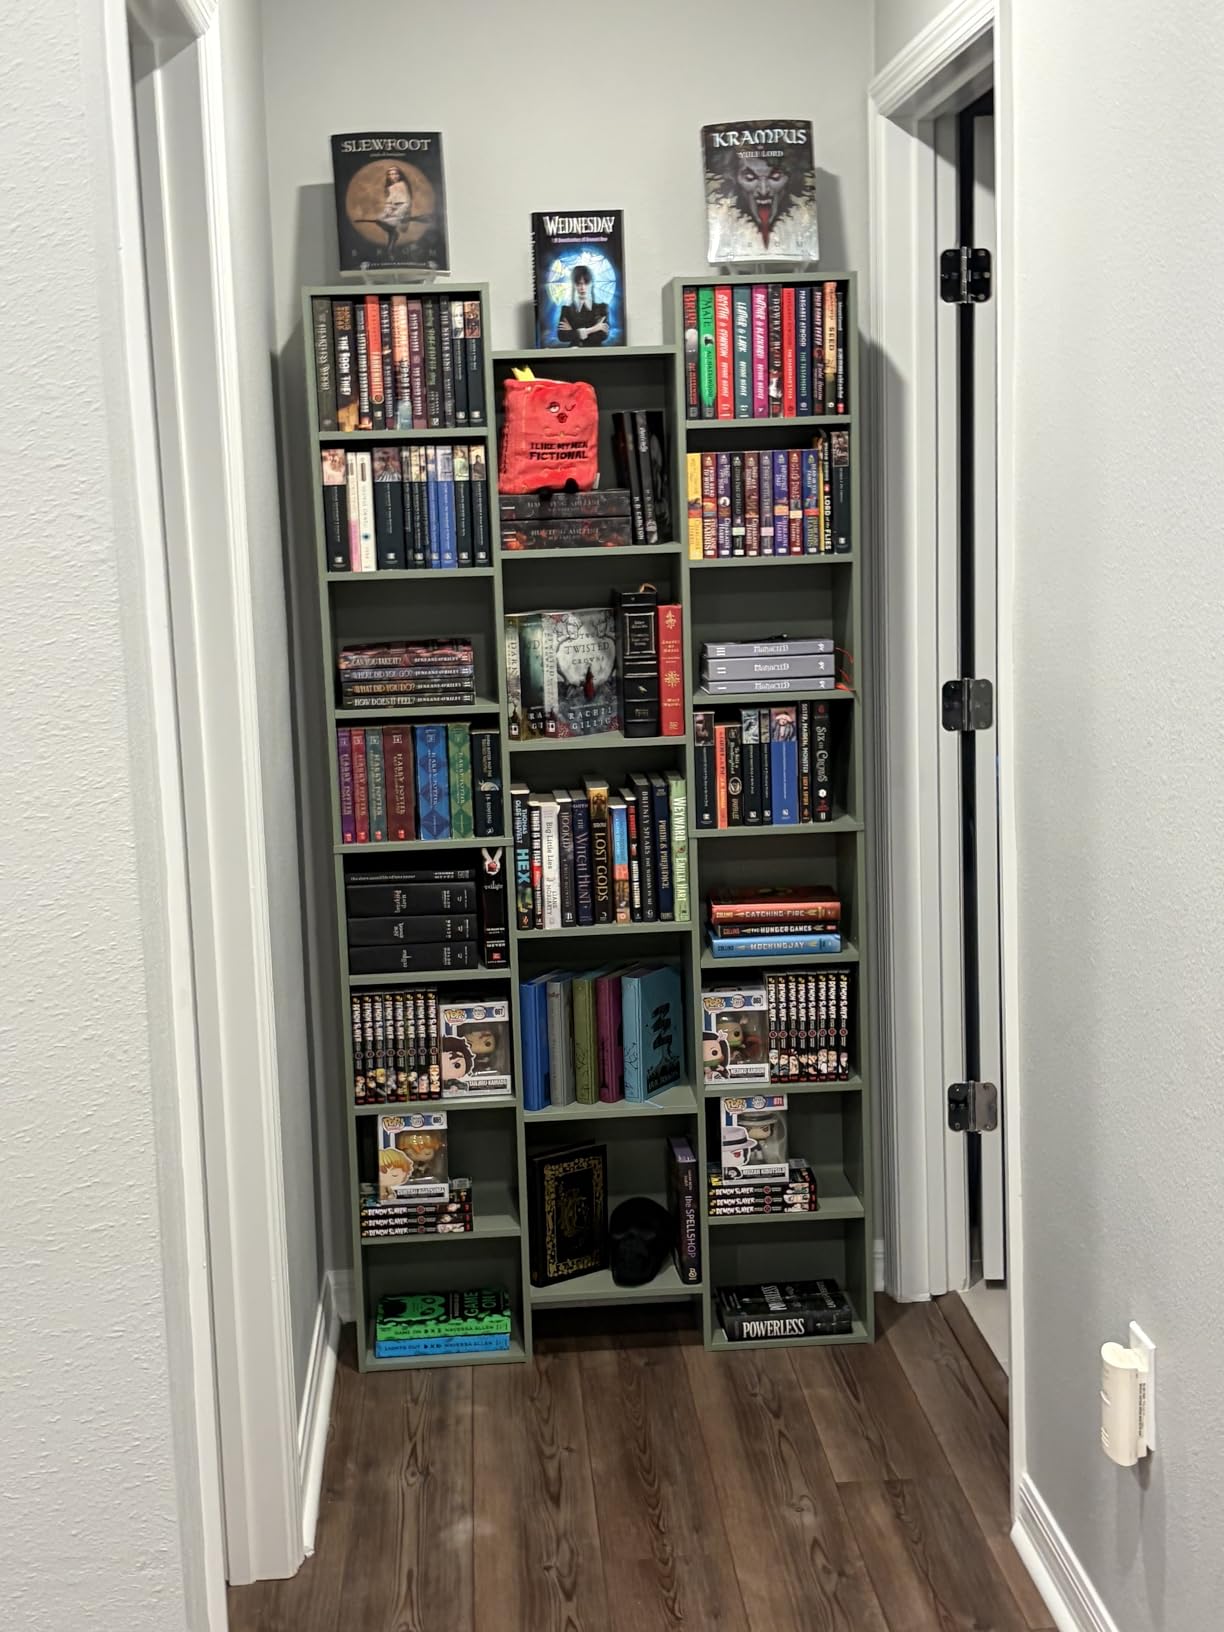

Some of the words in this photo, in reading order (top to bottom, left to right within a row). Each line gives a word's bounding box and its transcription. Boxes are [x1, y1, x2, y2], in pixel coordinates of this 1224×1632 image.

[342, 139, 431, 152] SLEWFOOT
[712, 128, 807, 147] KRAMPUS
[543, 216, 615, 236] WEDNESDAY
[684, 293, 697, 326] BRIDE
[701, 298, 712, 328] MATE
[718, 294, 729, 319] SCYTHE
[736, 302, 748, 327] LEATHER
[755, 294, 767, 320] BUTCHER
[772, 298, 781, 331] DOWRY
[338, 336, 349, 350] THE
[720, 329, 728, 357] SPARROW
[738, 336, 747, 352] LARK
[338, 352, 350, 373] BOOK
[340, 376, 351, 395] THIEF
[529, 452, 588, 460] FICTIONAL
[636, 511, 644, 539] CARLTON
[564, 642, 610, 654] TWISTED
[400, 670, 413, 678] GO?
[354, 685, 373, 693] WHAT
[374, 684, 385, 692] DID
[400, 684, 415, 692] DO?
[816, 727, 827, 741] SIX
[342, 754, 351, 782] HARRY
[396, 753, 404, 782] HARRY
[816, 750, 828, 782] CROWS
[344, 786, 352, 814] POTTER
[641, 791, 649, 824] BRITNEY
[531, 811, 540, 831] TENDER
[545, 822, 553, 833] Big
[673, 797, 687, 841] WEYWARD
[560, 812, 570, 848] HOOKED
[658, 820, 667, 842] PRIDE
[532, 839, 541, 849] THE
[576, 832, 587, 871] WITCH
[595, 833, 606, 861] LOST
[517, 849, 530, 883] HEX
[660, 851, 670, 888] PREJUDICE
[676, 858, 686, 881] EMILIA
[578, 875, 590, 903] HUNT
[597, 866, 608, 901] GODS
[677, 884, 687, 901] HART
[750, 942, 804, 950] MOCKINGJAY
[402, 949, 412, 967] eclipse
[778, 984, 786, 1002] DEMON
[788, 982, 796, 1000] DEMON
[798, 984, 806, 1002] DEMON
[808, 983, 816, 1000] DEMON
[818, 982, 826, 1000] DEMON
[828, 981, 836, 999] DEMON
[840, 981, 848, 1000] DEMON
[352, 1004, 360, 1022] DEMON
[363, 1003, 372, 1021] DEMON
[374, 1003, 382, 1021] DEMON
[384, 1001, 393, 1019] DEMON
[395, 1002, 403, 1020] DEMON
[416, 1000, 425, 1018] DEMON
[427, 1000, 436, 1018] DEMON
[779, 1003, 787, 1021] SLAYER
[789, 1001, 797, 1020] SLAYER
[798, 1003, 806, 1021] SLAYER
[808, 1002, 816, 1020] SLAYER
[819, 1001, 827, 1019] SLAYER
[840, 1000, 848, 1019] SLAYER
[354, 1023, 362, 1041] SLAYER
[364, 1022, 373, 1040] SLAYER
[375, 1022, 383, 1040] SLAYER
[386, 1020, 394, 1039] SLAYER
[396, 1021, 404, 1039] SLAYER
[418, 1019, 426, 1037] SLAYER
[428, 1019, 437, 1037] SLAYER
[684, 1196, 693, 1207] the
[368, 1208, 388, 1216] DEMON
[685, 1209, 696, 1257] SPELLSHOP
[464, 1292, 478, 1316] GAME
[742, 1318, 805, 1338] POWERLESS
